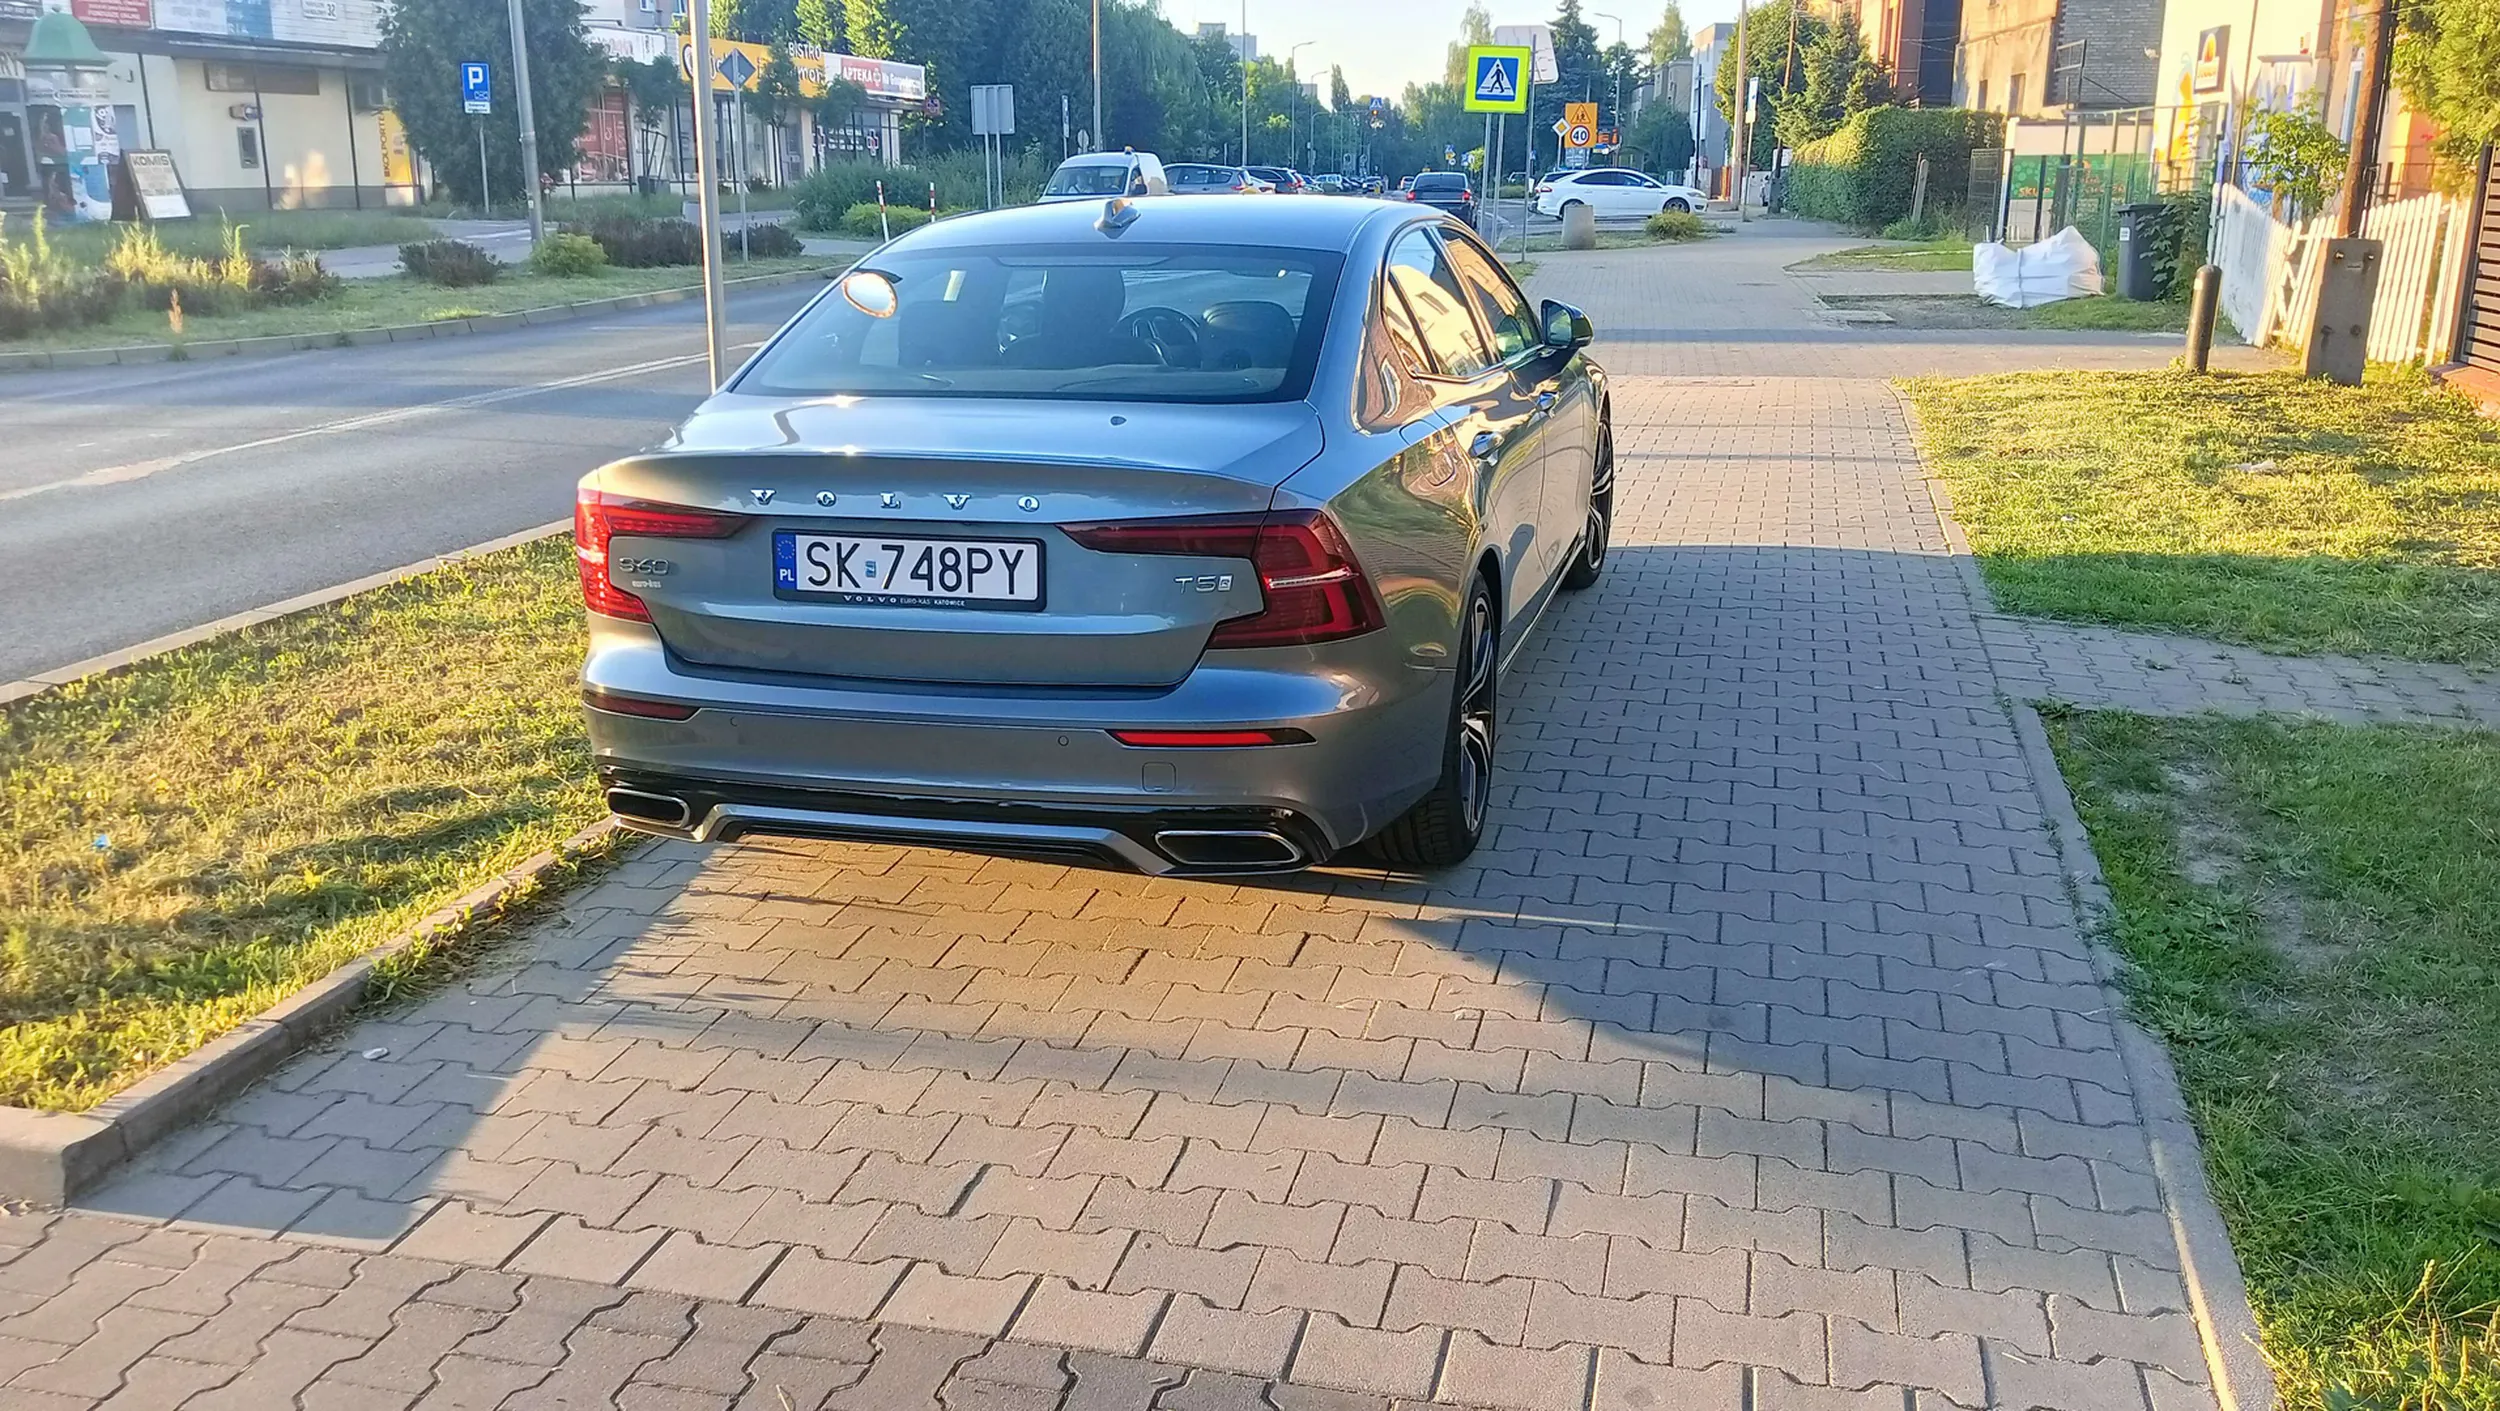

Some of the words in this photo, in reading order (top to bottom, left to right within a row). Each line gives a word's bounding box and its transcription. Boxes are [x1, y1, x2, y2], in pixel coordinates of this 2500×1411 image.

[327, 3, 336, 17] 32
[788, 42, 821, 60] BISTRO
[468, 67, 483, 90] P
[843, 67, 873, 83] APTEKA
[378, 112, 390, 170] KOLPORTE
[1573, 130, 1587, 141] 40
[132, 156, 169, 166] KOMIS
[750, 489, 1040, 512] VOLVO
[619, 557, 669, 574] S60
[805, 541, 861, 588] SK
[881, 544, 1024, 595] 748PY
[779, 568, 795, 582] PL
[843, 595, 897, 603] VOLVO
[900, 597, 931, 605] EURO-KAS
